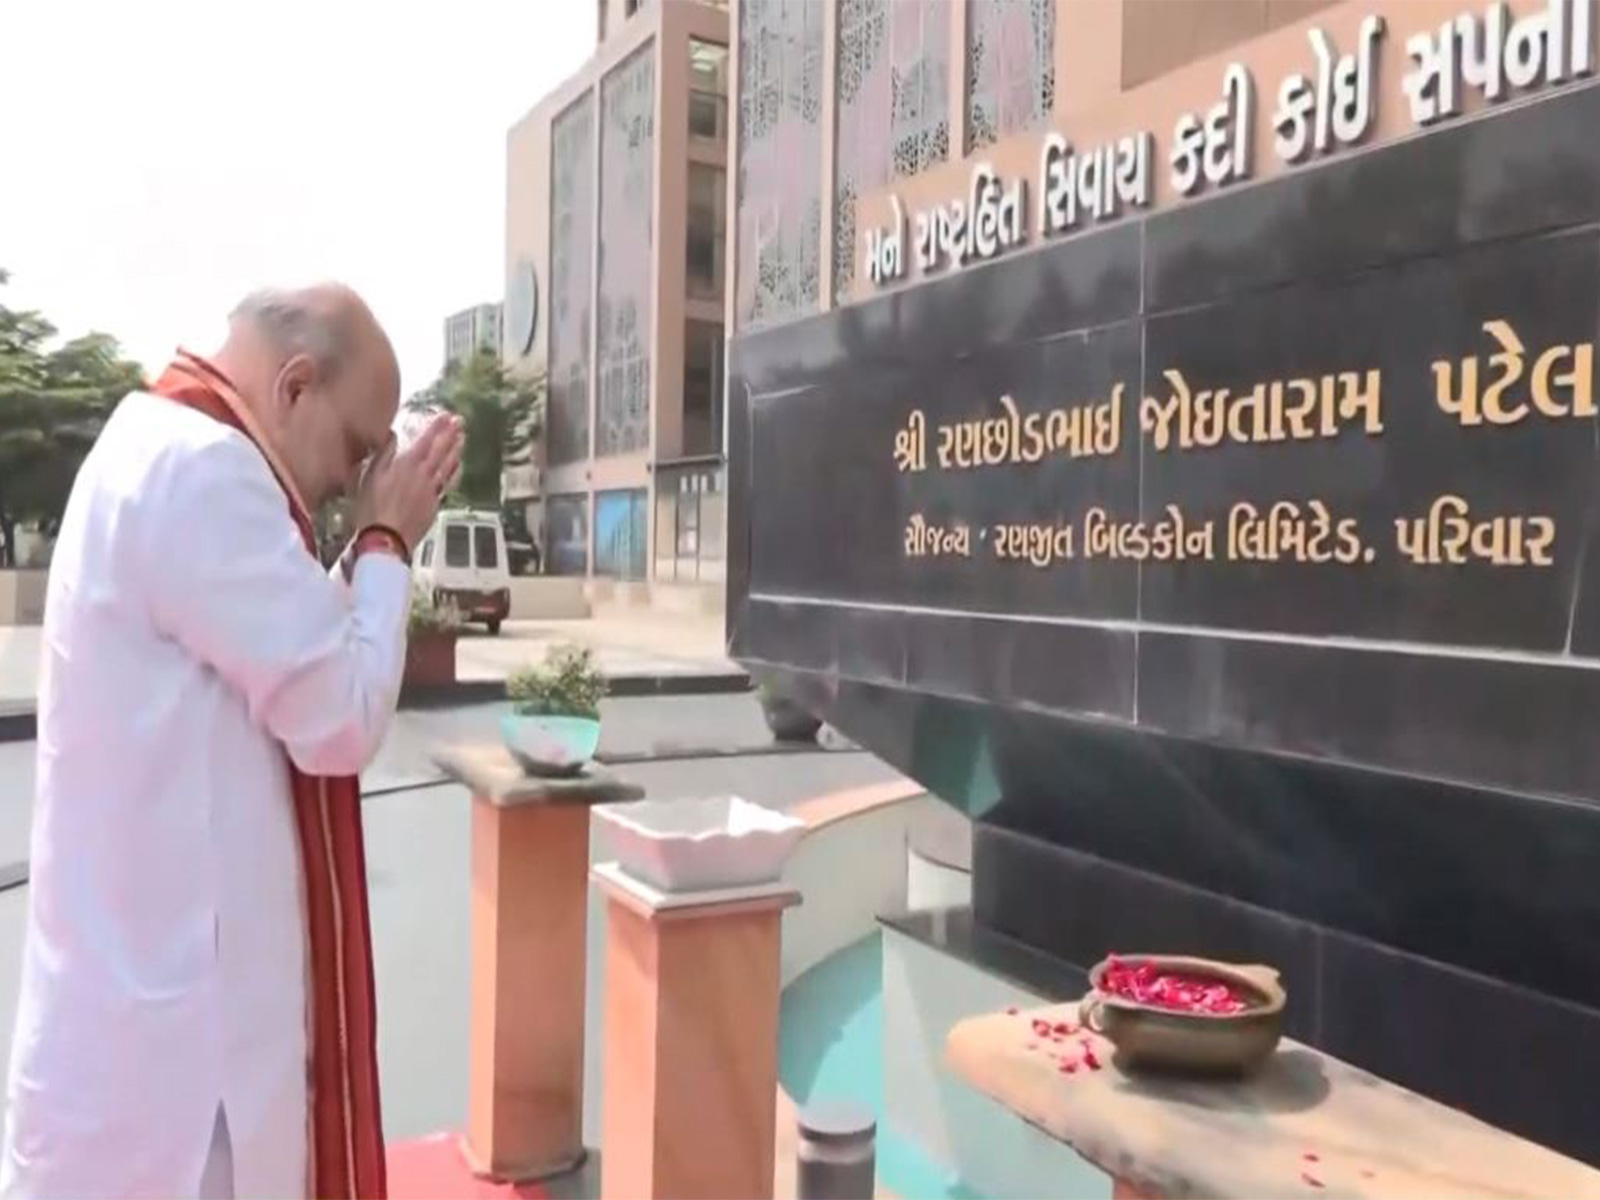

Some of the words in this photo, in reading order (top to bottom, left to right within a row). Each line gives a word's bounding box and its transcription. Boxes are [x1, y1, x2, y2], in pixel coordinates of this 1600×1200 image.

[865, 195, 904, 283] મને
[1037, 133, 1148, 235] સિવાય
[1169, 62, 1247, 193] કદી
[1273, 14, 1382, 162] કોઈ
[894, 410, 925, 471] શ્રી
[938, 382, 1125, 467] રણછોડભાઈ
[1431, 319, 1598, 426] પટેલ
[904, 514, 969, 556] સૌજન્ય
[994, 525, 1073, 567] રણજીત
[1084, 505, 1213, 560] બિલ્ડકોન
[1393, 494, 1556, 566] પરિવાર
